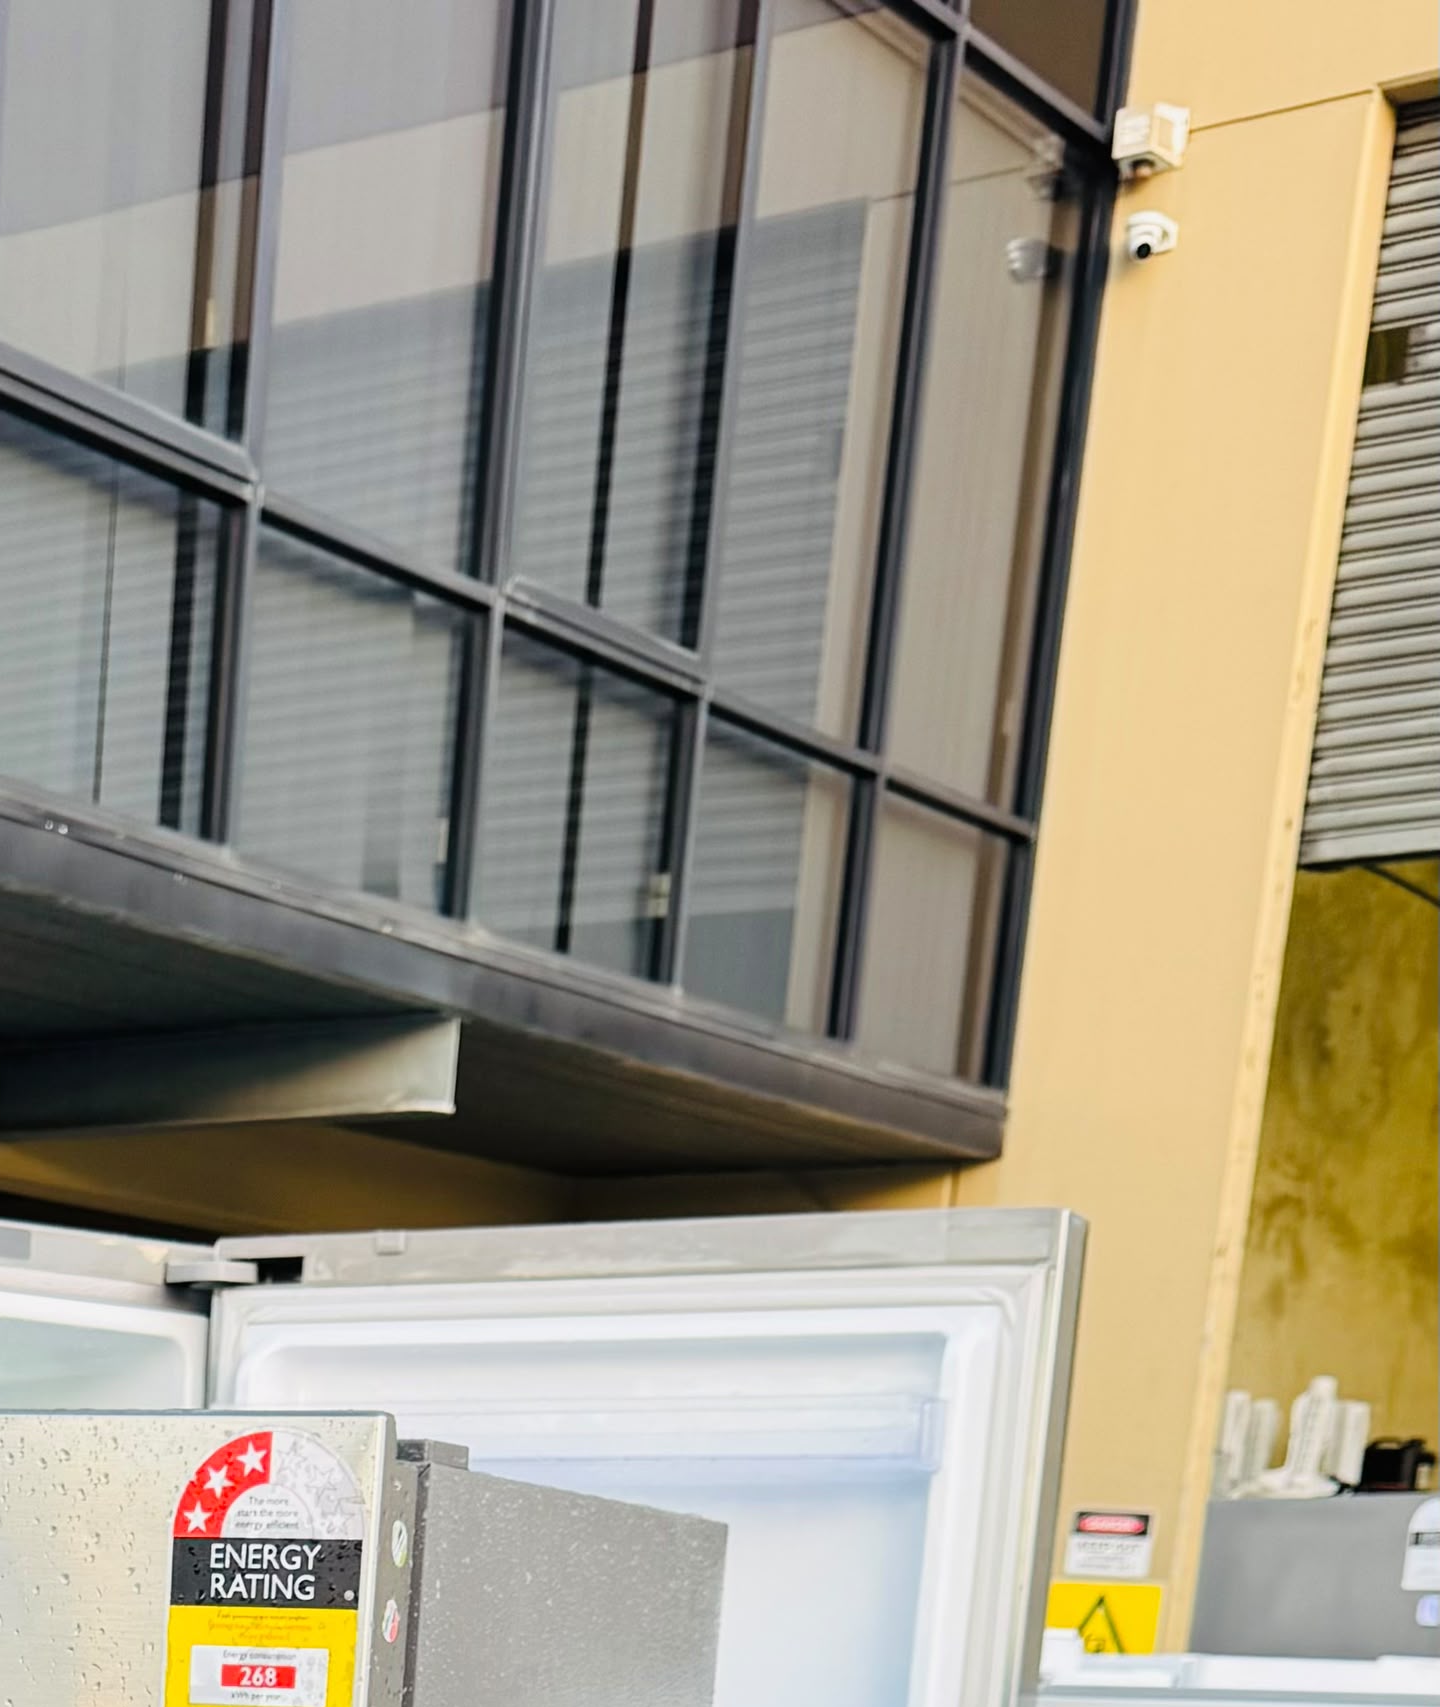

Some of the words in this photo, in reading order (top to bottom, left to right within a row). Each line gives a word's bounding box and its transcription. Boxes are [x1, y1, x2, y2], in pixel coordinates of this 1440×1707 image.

[210, 1543, 322, 1571] ENERGY
[210, 1572, 316, 1601] RATING
[239, 1666, 278, 1687] 268
